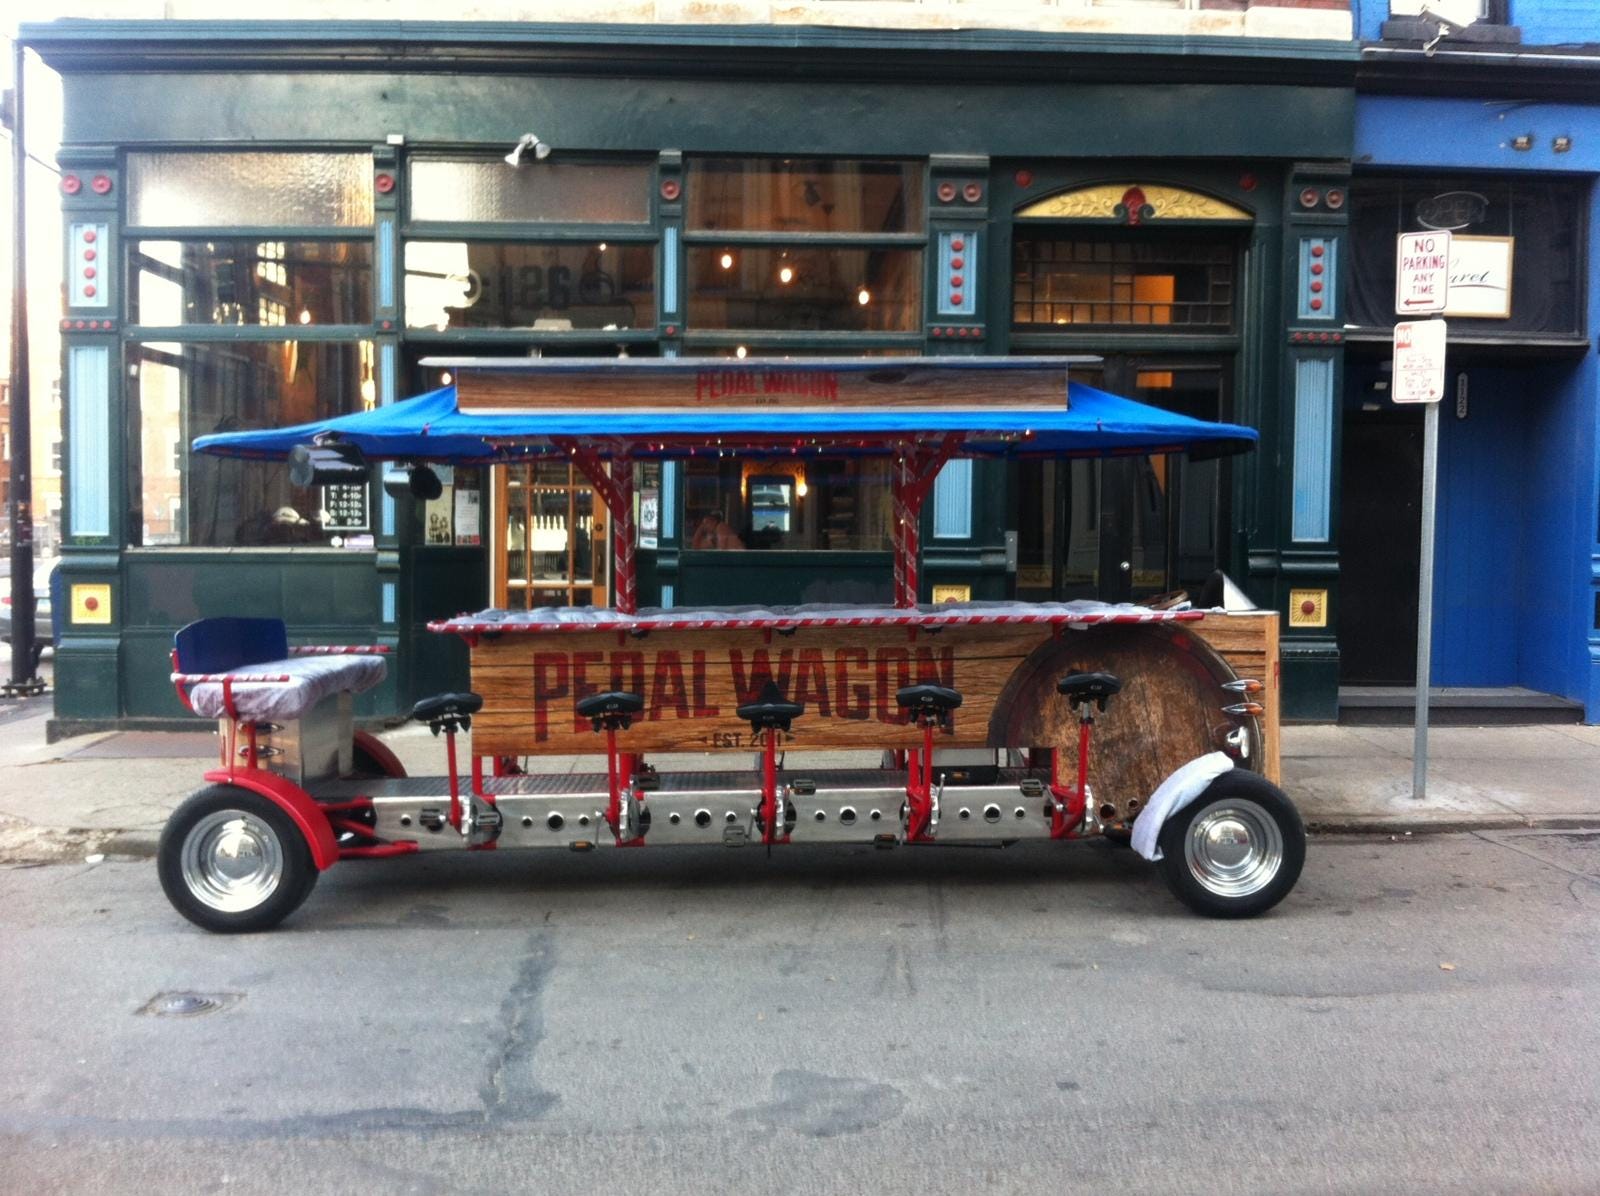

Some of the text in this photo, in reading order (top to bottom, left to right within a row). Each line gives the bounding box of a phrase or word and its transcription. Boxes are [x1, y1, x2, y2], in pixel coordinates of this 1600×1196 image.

[1414, 239, 1435, 253] NO
[1403, 255, 1446, 271] PARKING
[1412, 273, 1435, 283] ANY
[1412, 285, 1435, 295] TIME
[697, 371, 758, 402] PEDAL
[534, 646, 955, 743] PEDAL WAGON
[712, 731, 782, 749] EST. 201
